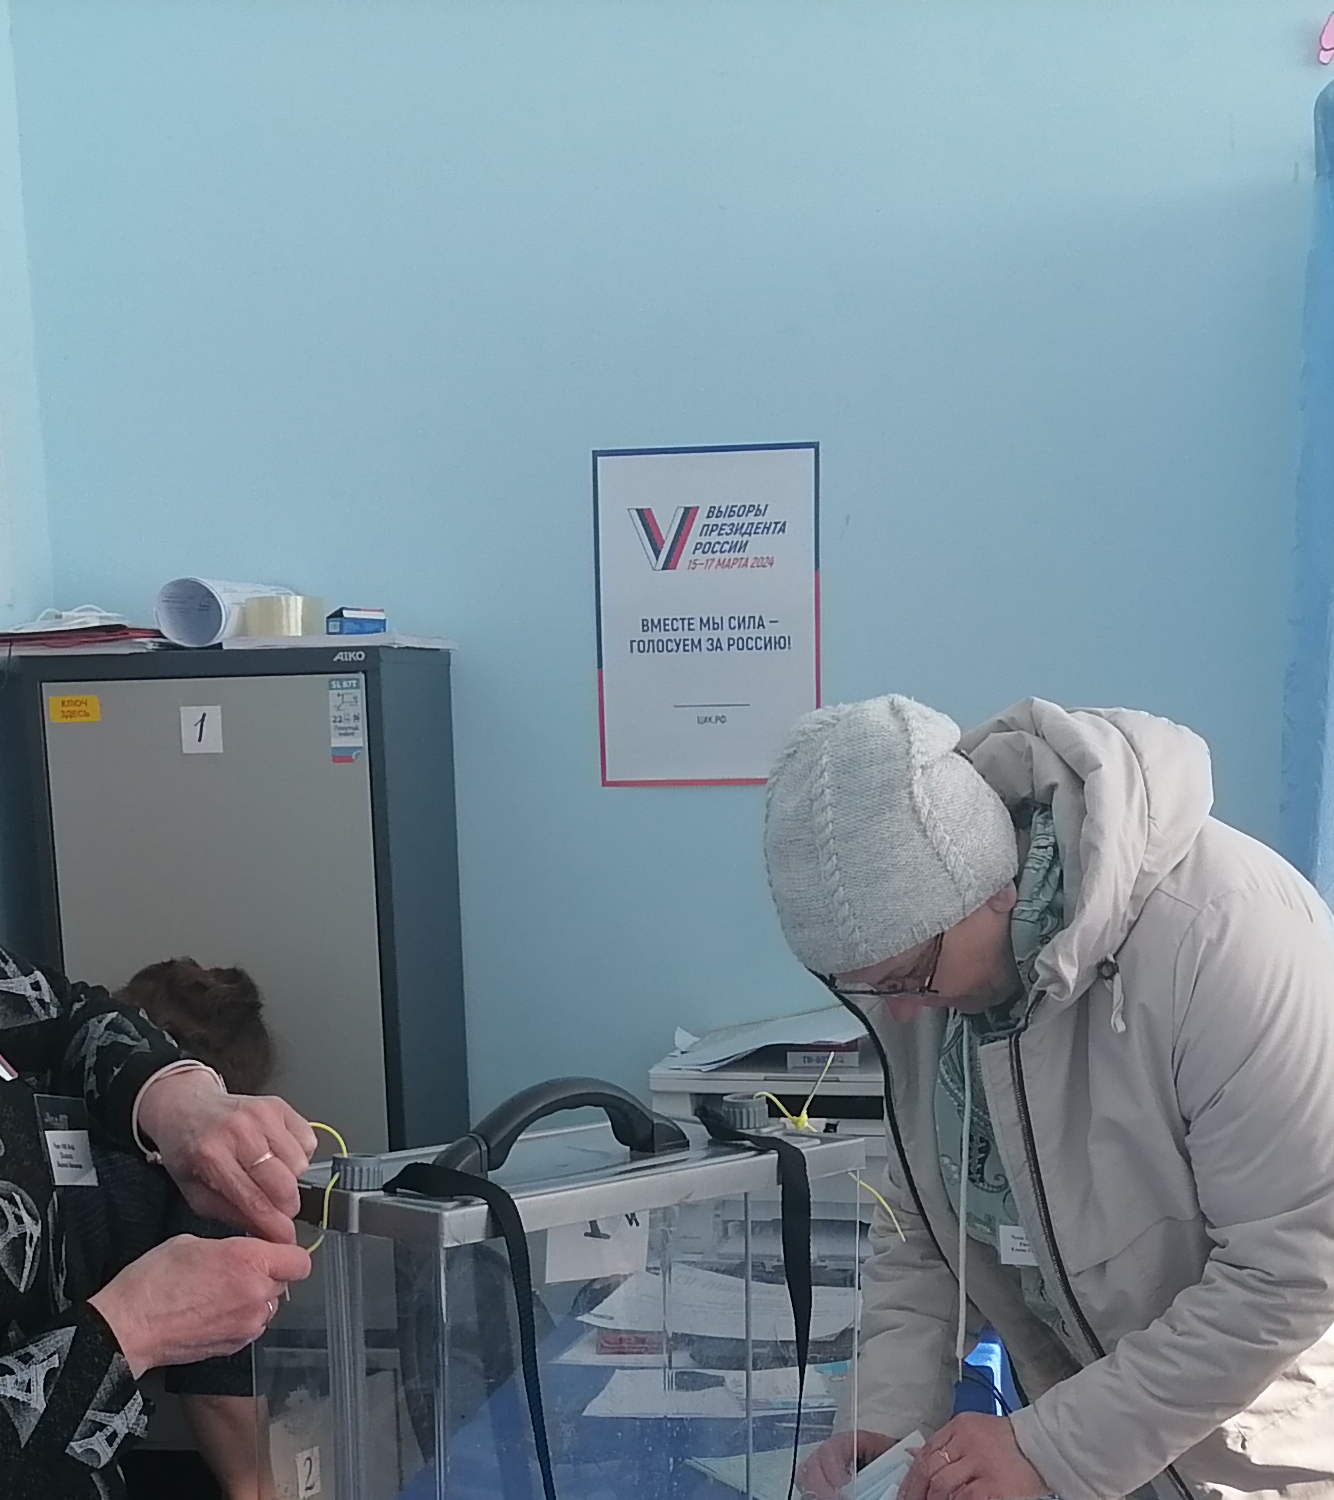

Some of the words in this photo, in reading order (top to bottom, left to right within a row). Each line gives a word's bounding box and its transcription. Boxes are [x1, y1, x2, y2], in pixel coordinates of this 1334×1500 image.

[705, 503, 769, 519] ВЫБОРЫ
[698, 520, 788, 537] ПРЕЗИДЕНТА
[692, 540, 749, 555] РОССИИ
[714, 557, 749, 570] МАРТА
[749, 556, 775, 569] 2024
[640, 617, 695, 633] ВМЕСТЕ
[699, 616, 725, 632] МЫ
[728, 615, 766, 631] СИЛА
[629, 637, 702, 654] ГОЛОСУЕМ
[706, 637, 724, 652] ЗА
[727, 635, 792, 652] РОССИЮ!
[332, 650, 365, 662] AIKO
[193, 712, 208, 743] 1
[303, 1456, 316, 1491] 2
